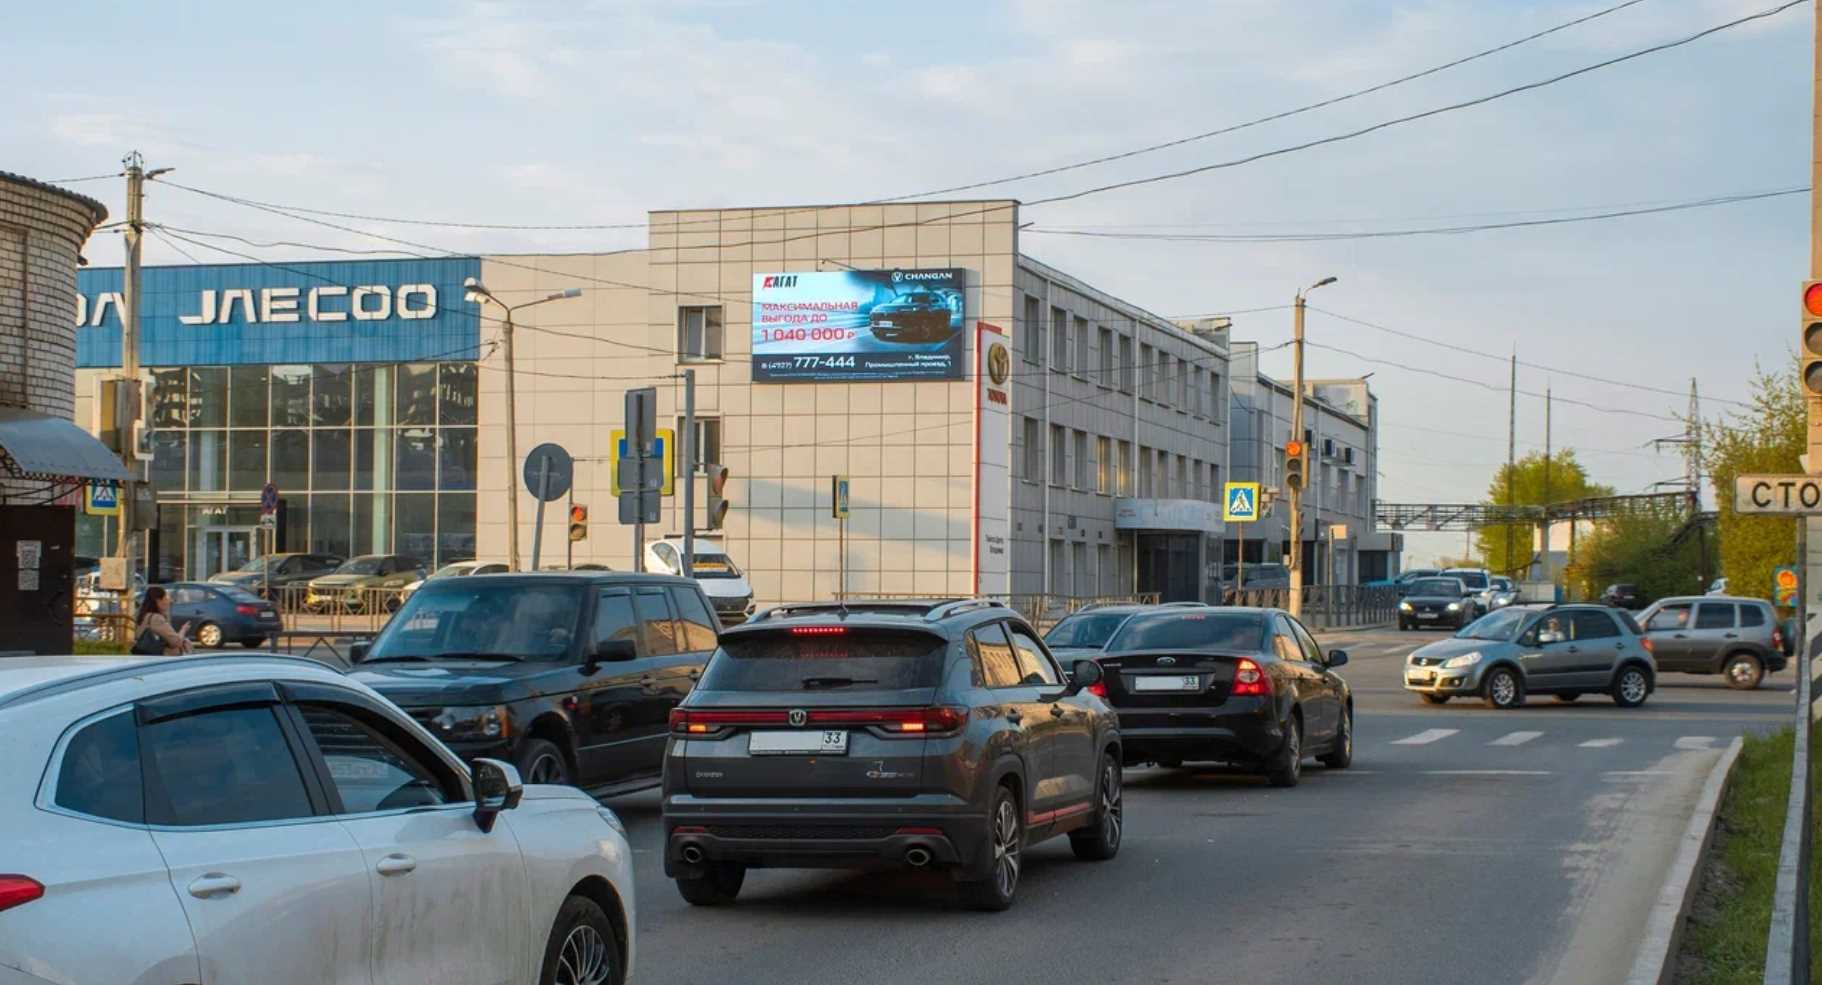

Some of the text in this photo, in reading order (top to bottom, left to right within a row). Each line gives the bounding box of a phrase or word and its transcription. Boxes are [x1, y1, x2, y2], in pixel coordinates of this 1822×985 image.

[905, 272, 953, 280] CHANGAN
[178, 283, 437, 325] JAECOO
[762, 302, 858, 312] МАКСИМАЛЬНАЯ
[762, 314, 828, 324] ВЫГОДА ДО
[774, 328, 806, 341] 040
[811, 328, 845, 340] 000
[793, 356, 855, 368] 777-444
[1752, 482, 1820, 508] СТО
[825, 732, 841, 744] 33
